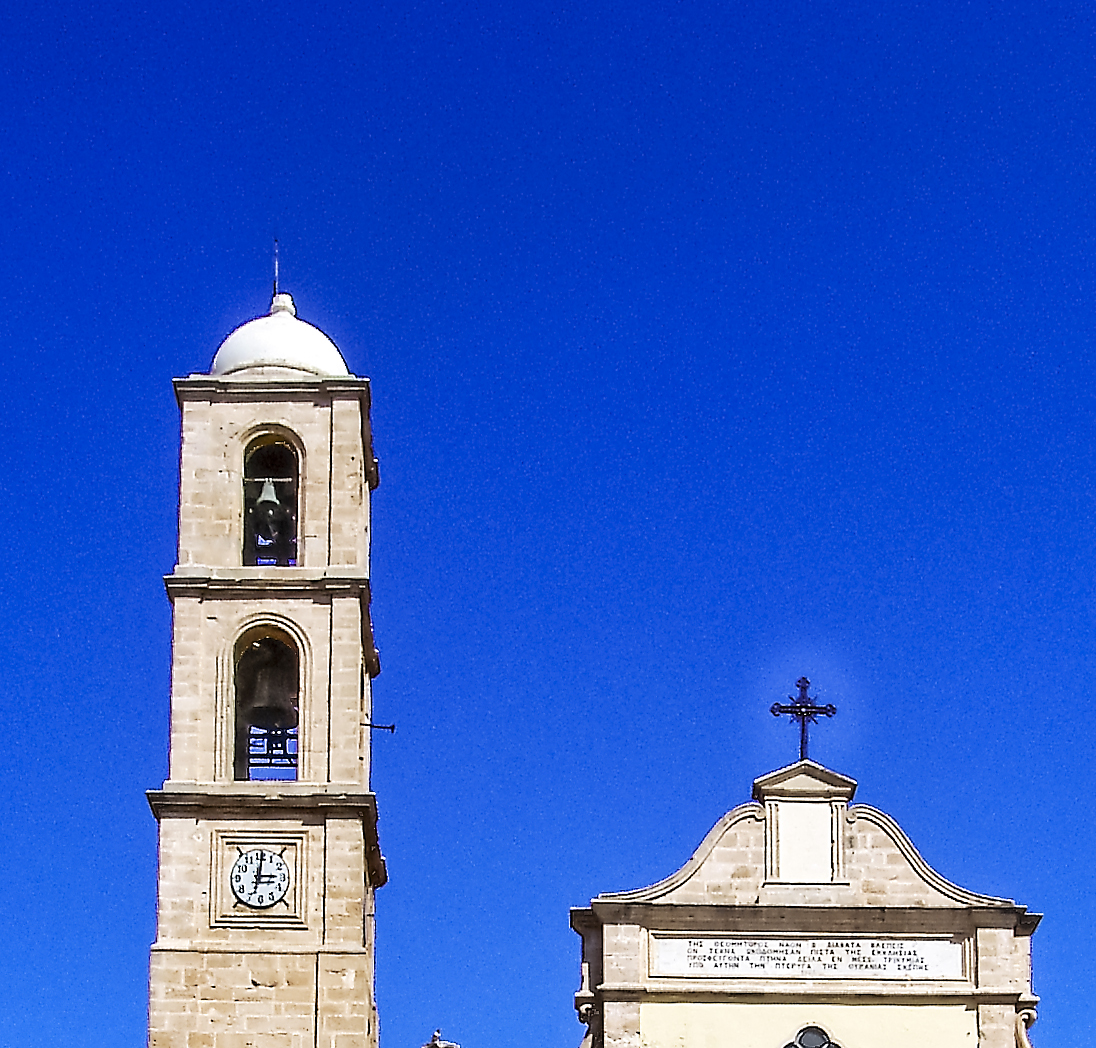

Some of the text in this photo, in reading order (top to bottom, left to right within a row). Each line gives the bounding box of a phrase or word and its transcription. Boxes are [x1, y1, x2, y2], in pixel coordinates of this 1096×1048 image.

[245, 856, 253, 864] 11
[238, 865, 247, 873] 10
[276, 862, 282, 870] 2
[239, 885, 244, 893] 8
